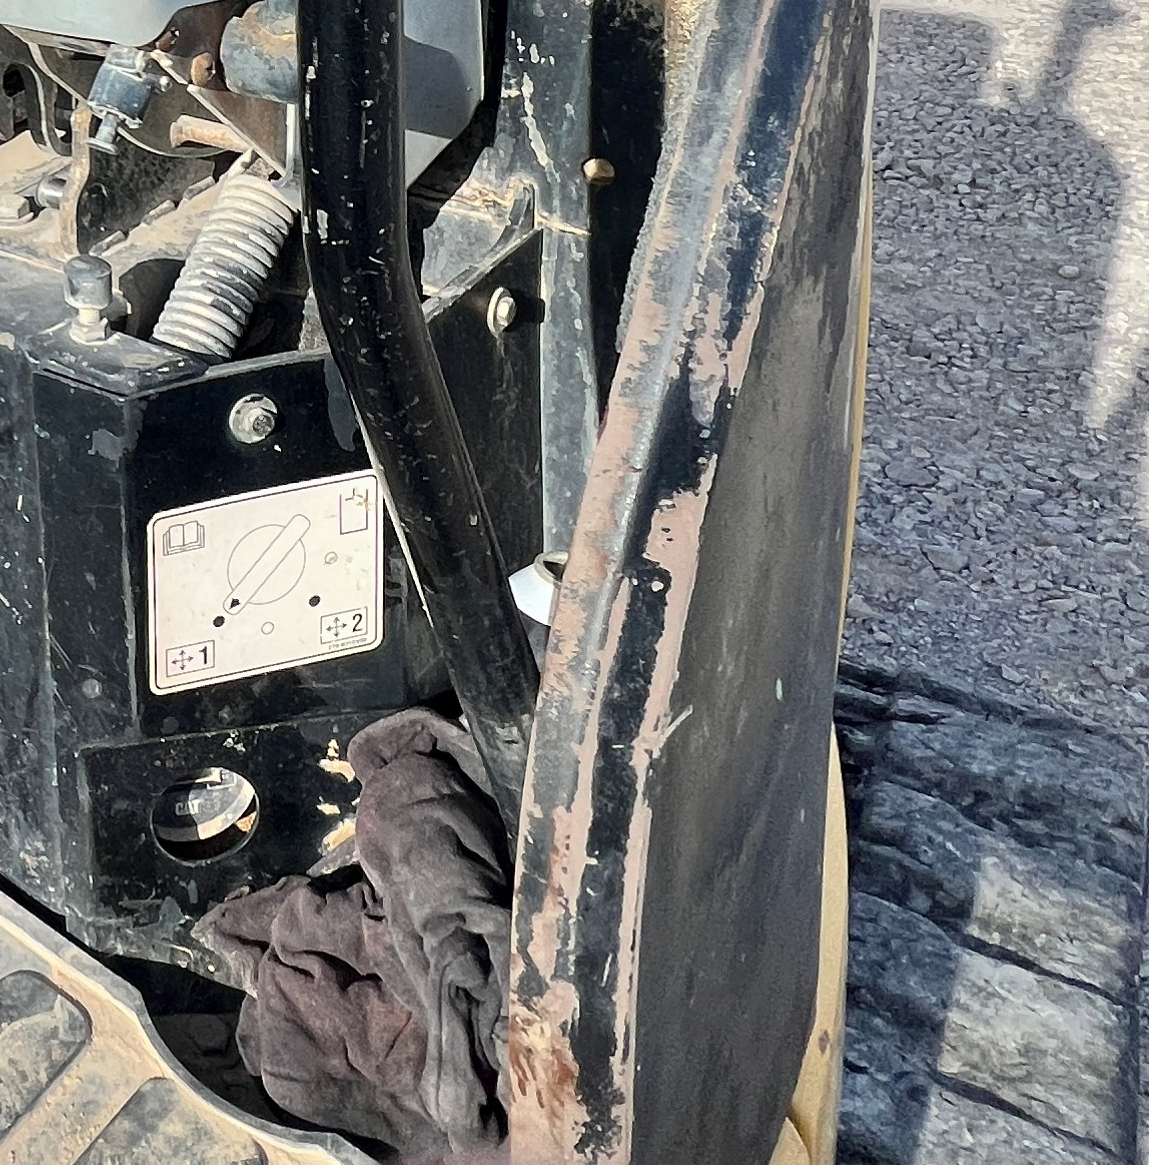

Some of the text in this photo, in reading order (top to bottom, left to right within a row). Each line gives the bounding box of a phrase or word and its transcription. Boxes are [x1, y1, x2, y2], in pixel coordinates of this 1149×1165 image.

[352, 613, 363, 632] 2
[198, 645, 207, 665] 1
[175, 798, 201, 816] CAT
